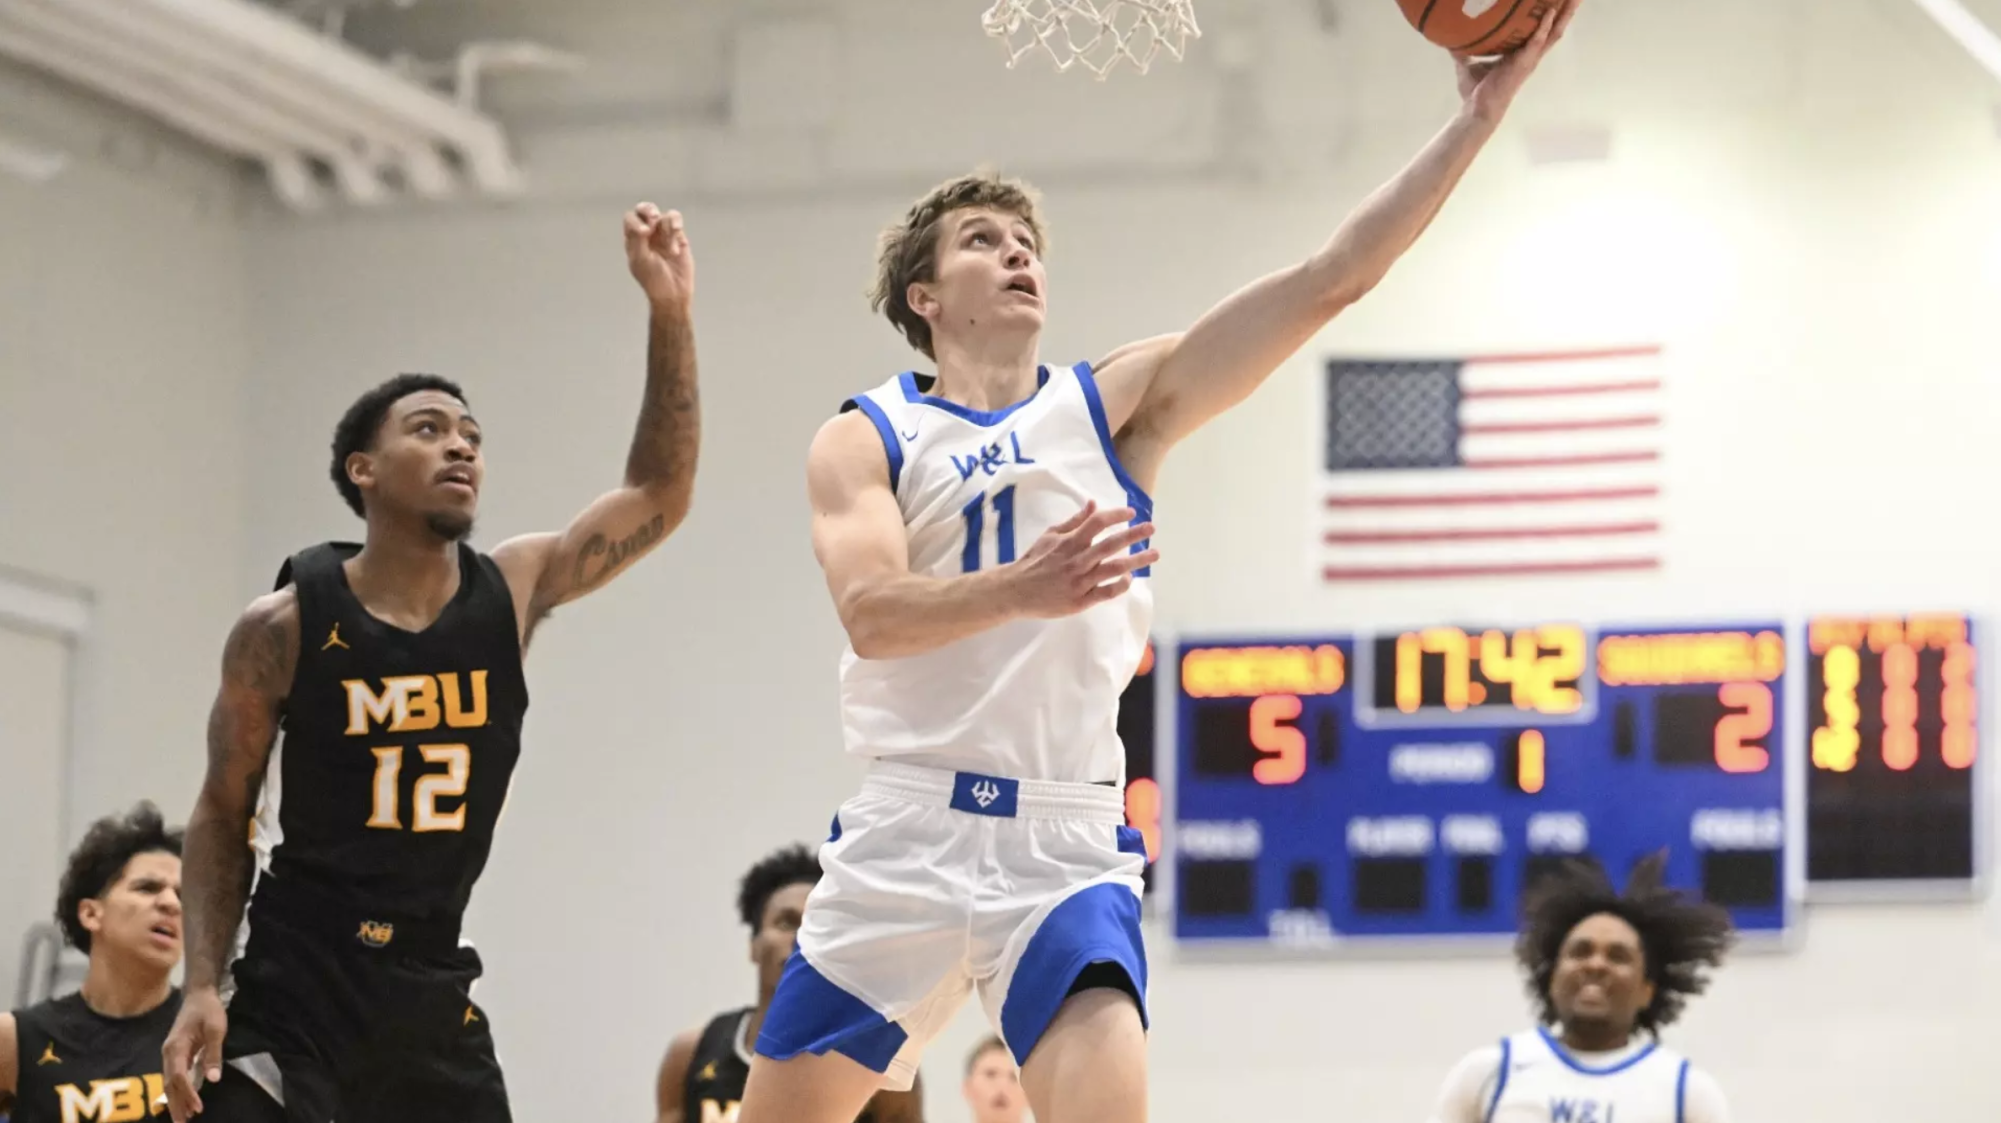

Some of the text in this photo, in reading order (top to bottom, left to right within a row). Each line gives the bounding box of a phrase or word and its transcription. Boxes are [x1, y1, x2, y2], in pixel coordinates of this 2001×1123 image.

[950, 430, 1036, 482] W&L
[960, 482, 1017, 574] 11
[341, 669, 490, 736] MBU
[1249, 694, 1307, 785] 5
[1713, 681, 1774, 774] 2
[365, 743, 472, 833] 12
[1517, 728, 1546, 794] 1
